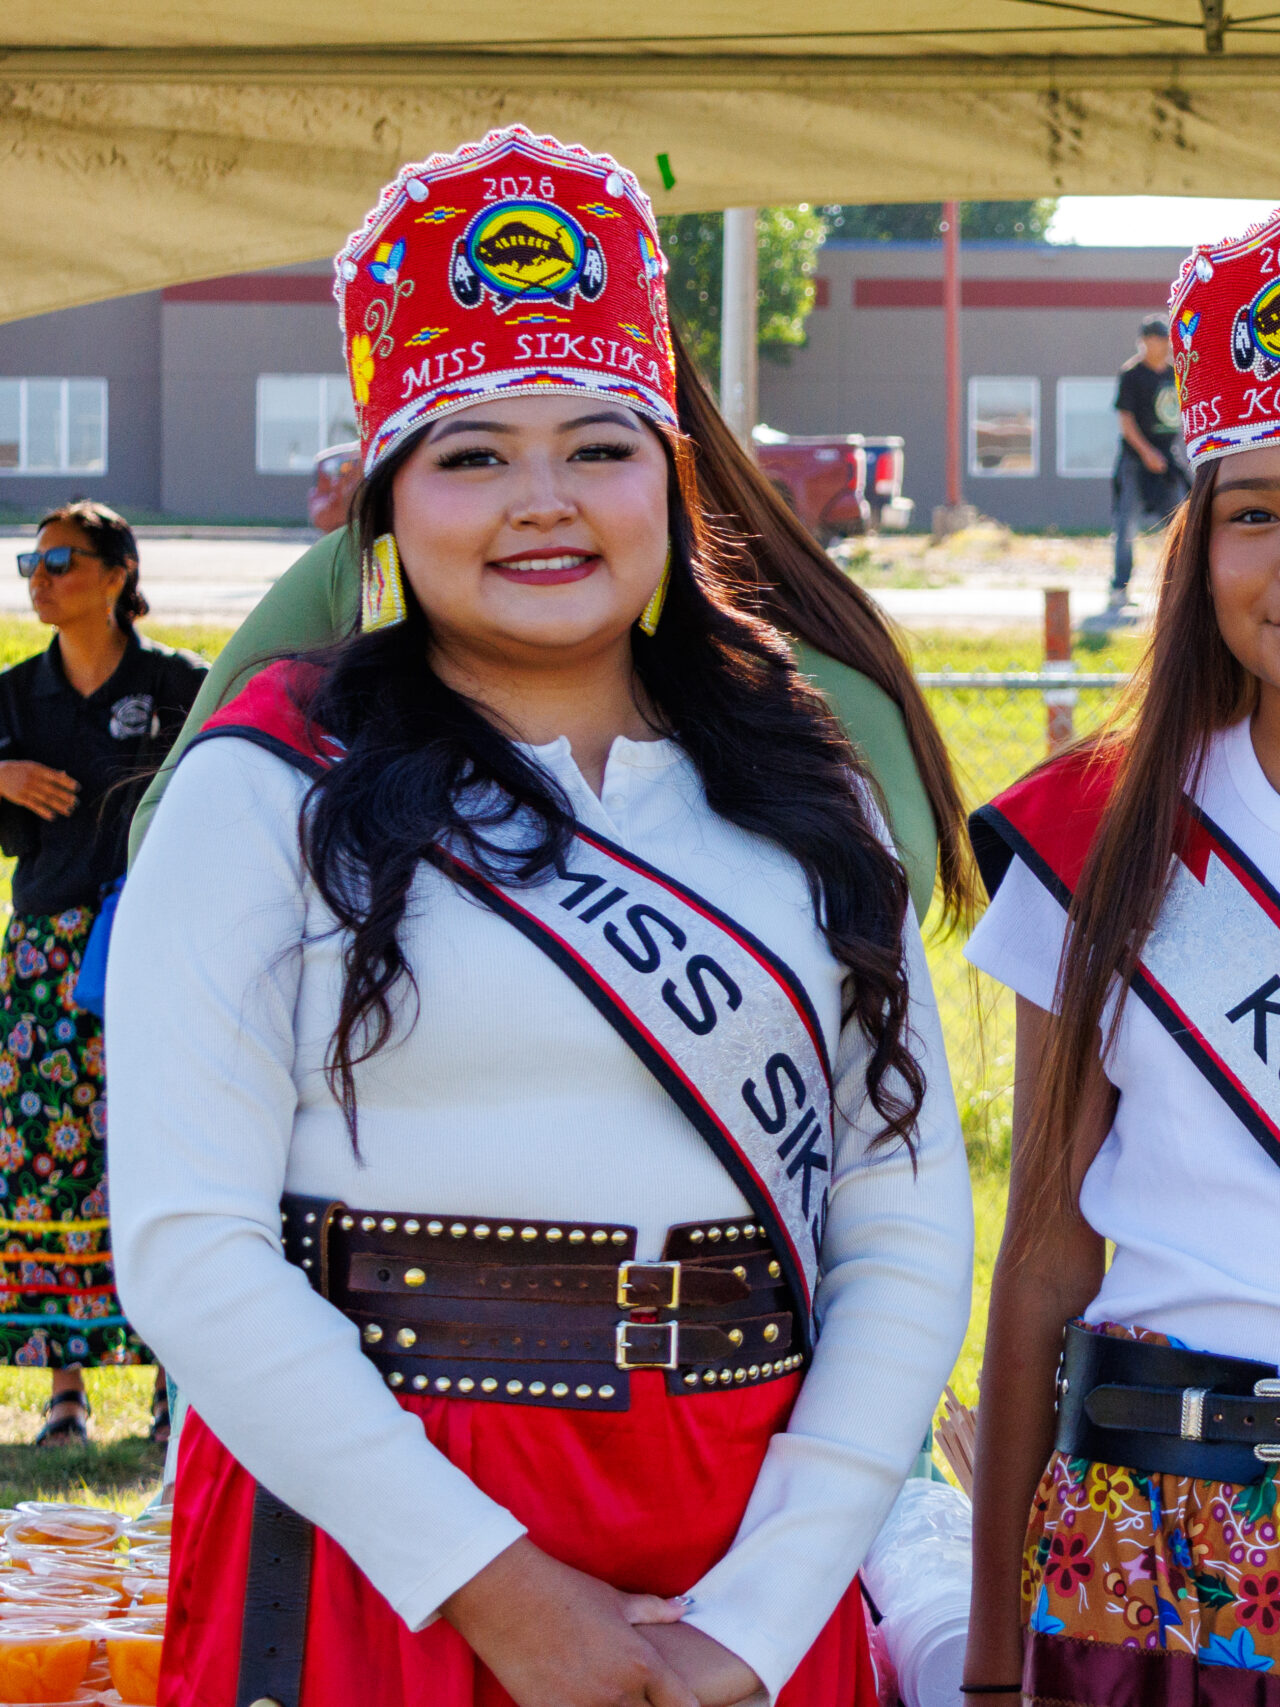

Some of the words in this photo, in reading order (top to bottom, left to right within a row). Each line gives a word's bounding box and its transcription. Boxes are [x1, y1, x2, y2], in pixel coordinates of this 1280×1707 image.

[482, 176, 555, 199] 2026
[401, 341, 486, 398] MISS
[514, 333, 663, 389] SIKSIKA
[514, 846, 743, 1036] MISS
